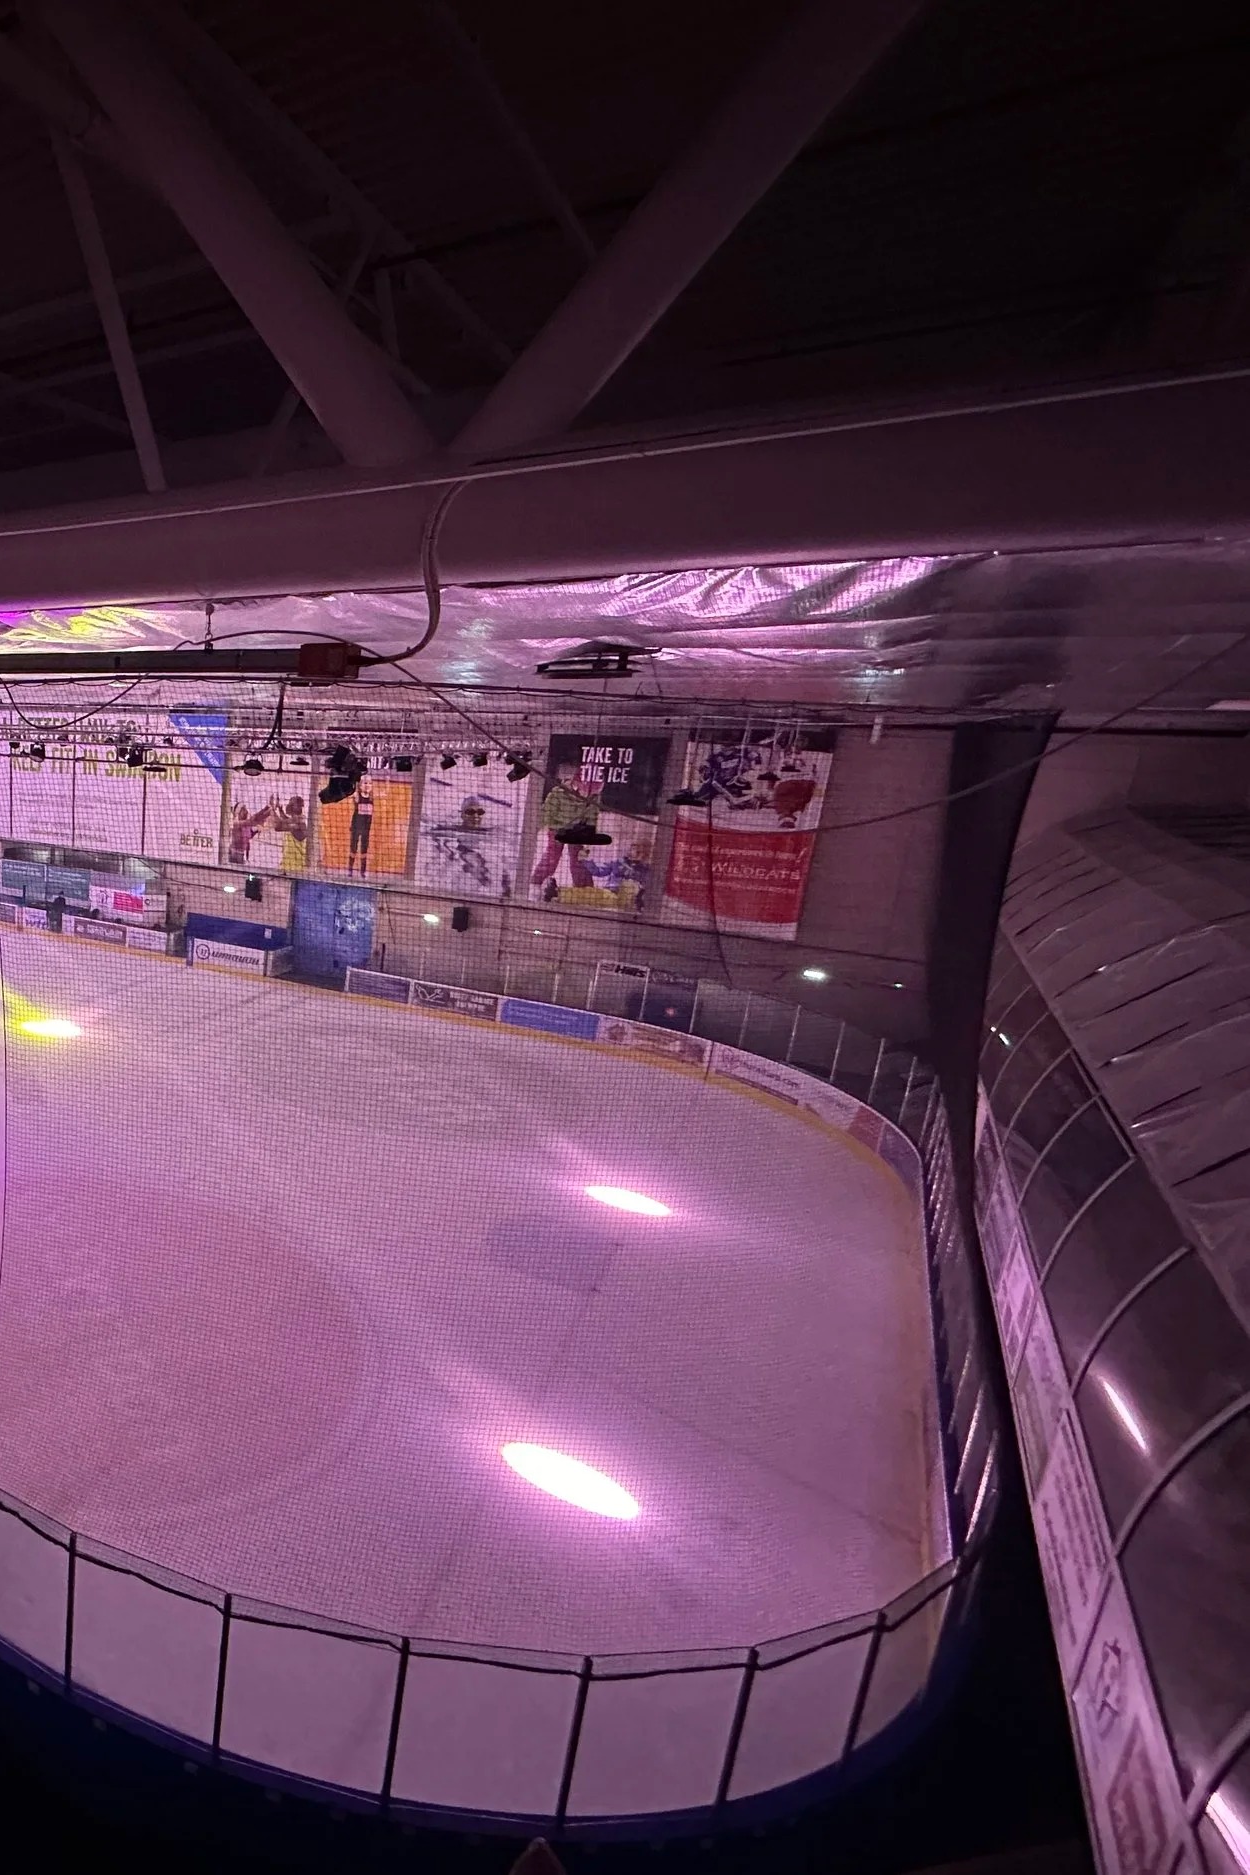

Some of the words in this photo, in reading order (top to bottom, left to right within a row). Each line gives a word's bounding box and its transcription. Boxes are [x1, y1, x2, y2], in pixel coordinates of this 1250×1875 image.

[581, 746, 613, 764] TAKE
[617, 747, 634, 764] TO
[579, 765, 605, 783] THE
[607, 766, 630, 784] ICE
[711, 861, 801, 880] WILDCATS
